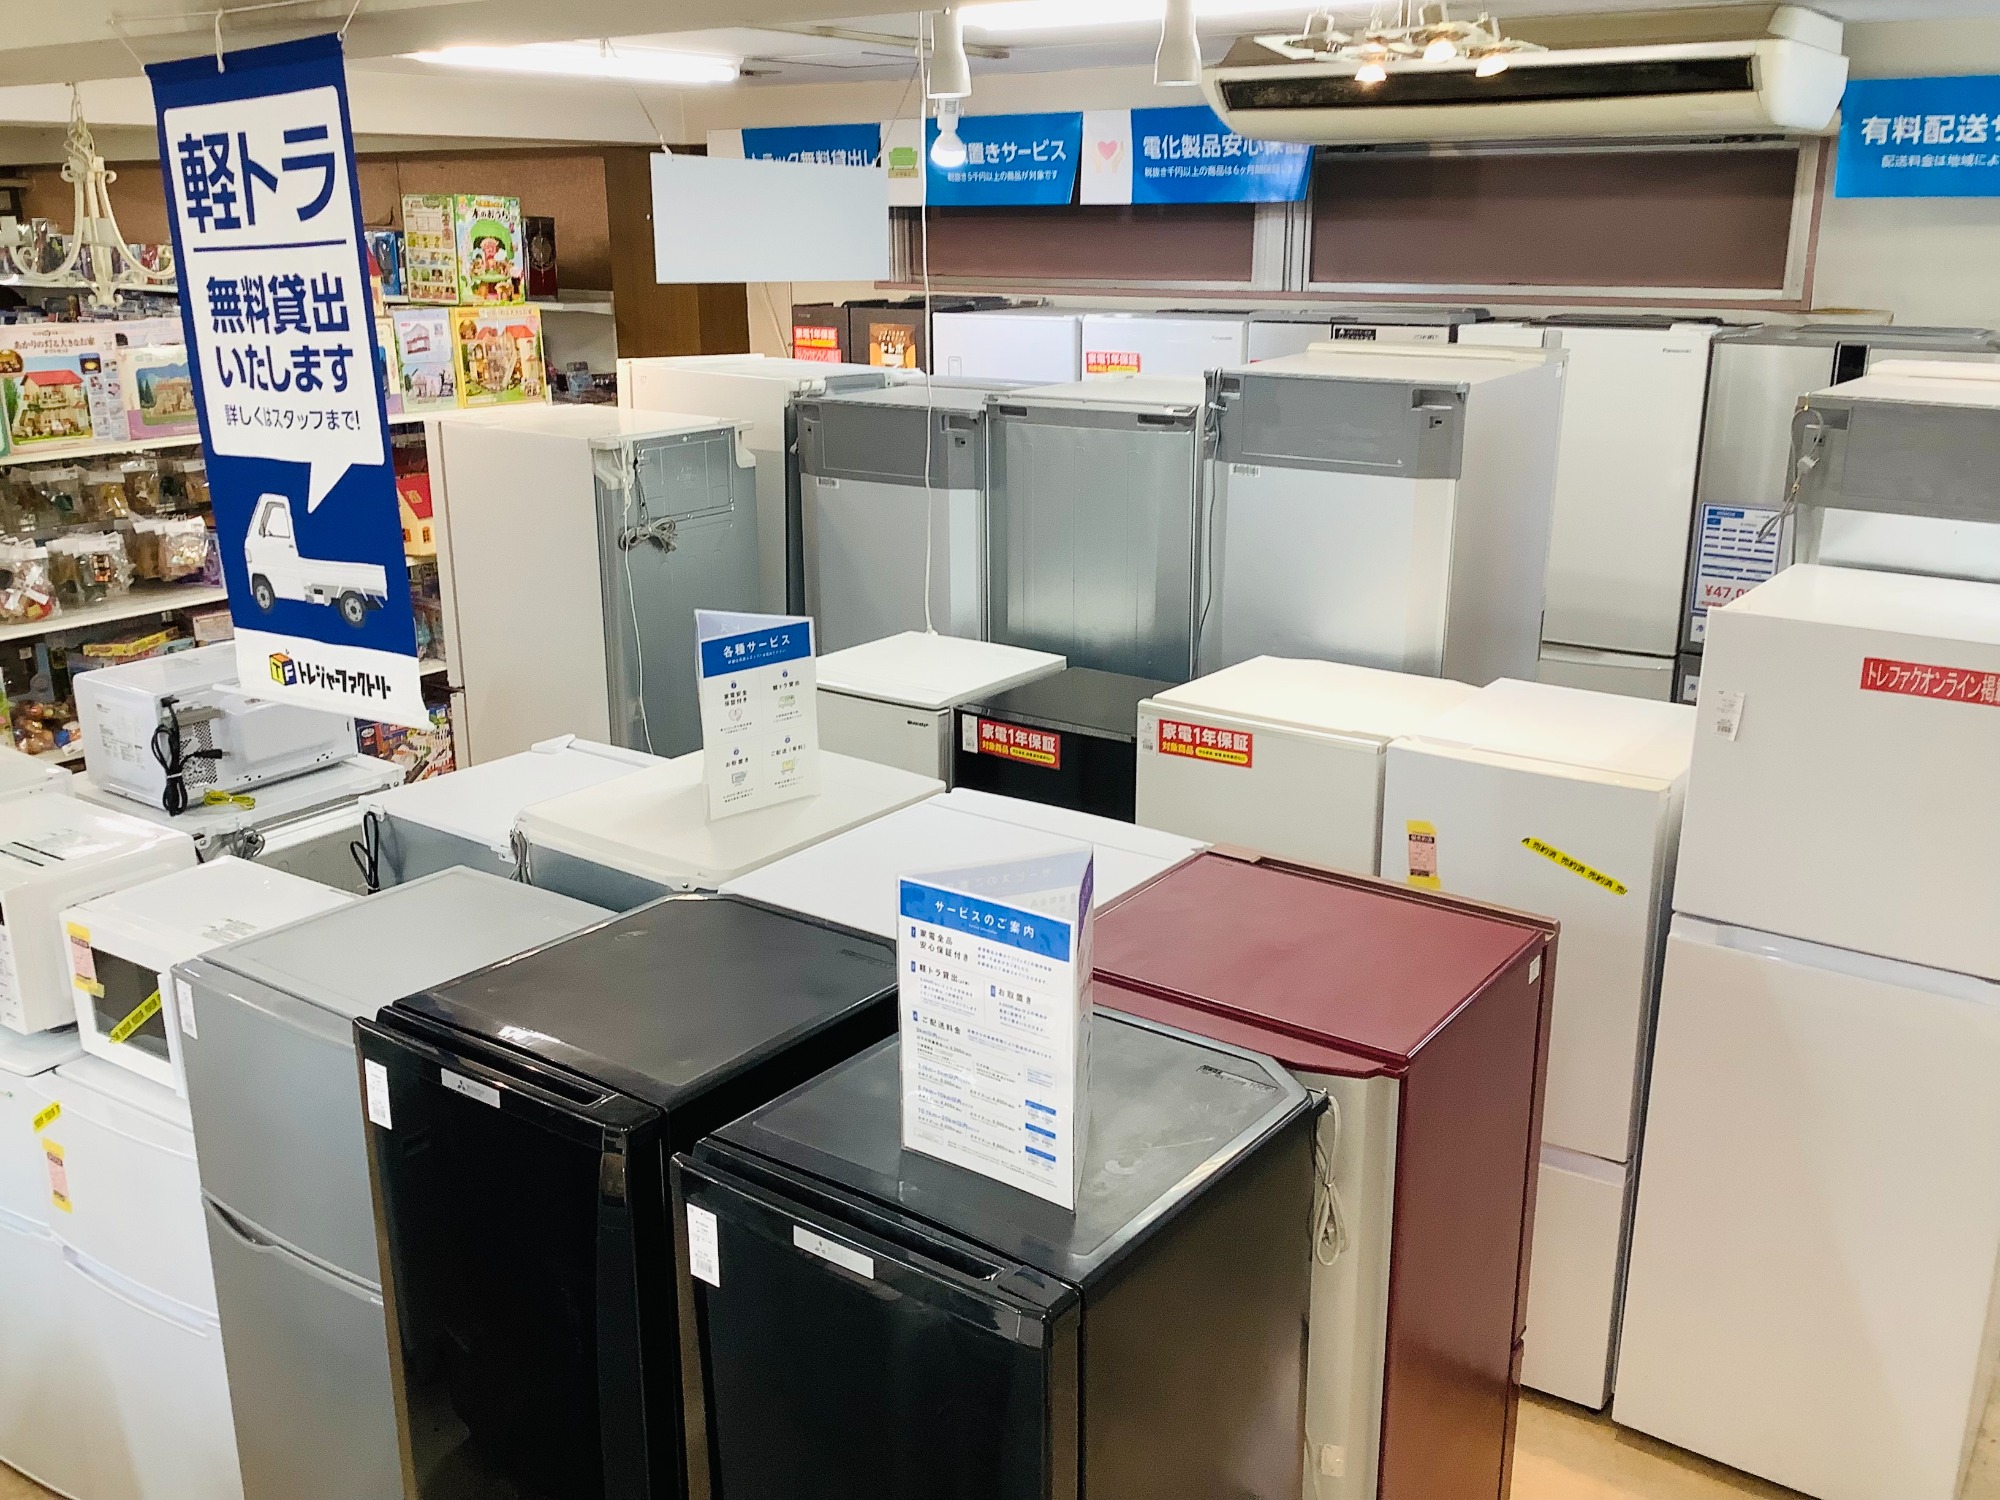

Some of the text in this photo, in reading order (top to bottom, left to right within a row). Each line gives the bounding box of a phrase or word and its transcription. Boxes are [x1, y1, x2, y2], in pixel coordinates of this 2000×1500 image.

[964, 139, 1067, 164] 置きサービス
[177, 124, 336, 234] 軽トラ
[206, 272, 350, 336] 無料貸出
[216, 343, 354, 393] いたします
[1704, 584, 1753, 601] ¥47,0
[723, 634, 791, 658] 各種サービス
[298, 661, 391, 700] トレジャーファクトリー
[981, 722, 1056, 753] 家電1年保証
[1162, 723, 1249, 751] 家電1年保証
[935, 900, 1035, 939] サービスのご案内
[920, 940, 969, 962] 安心保証付き
[920, 963, 958, 983] 軽トラ貸出
